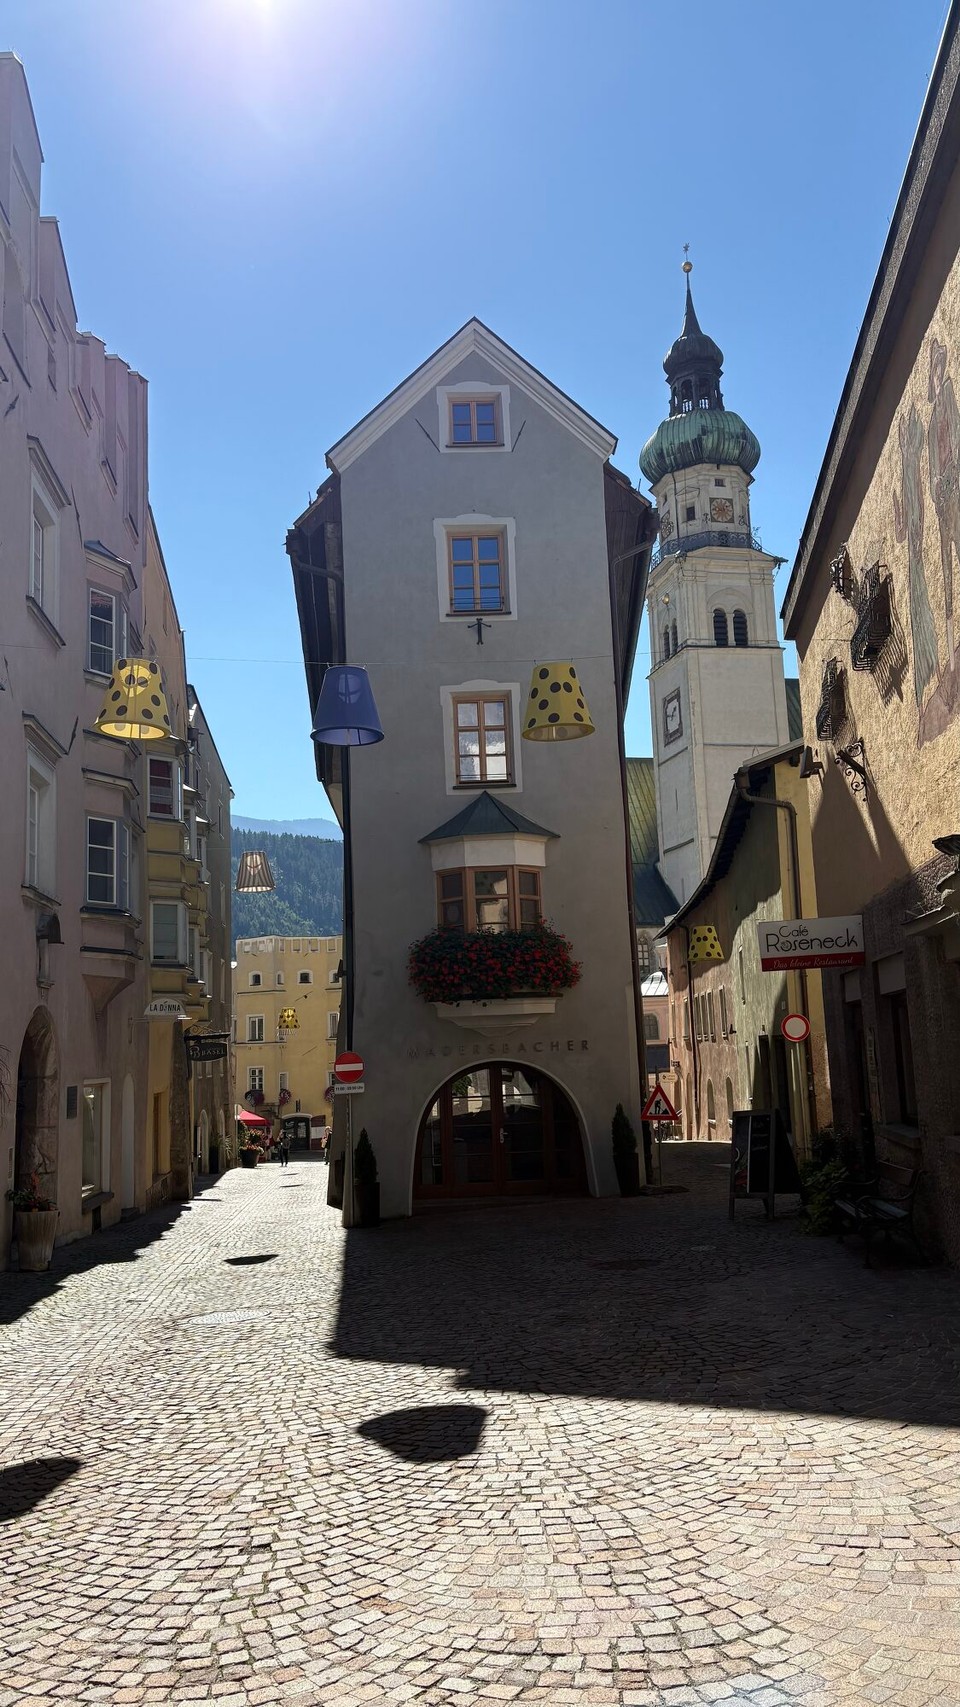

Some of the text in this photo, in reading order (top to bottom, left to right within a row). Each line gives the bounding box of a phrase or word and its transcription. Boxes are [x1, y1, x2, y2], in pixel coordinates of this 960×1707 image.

[779, 924, 809, 938] Café
[766, 928, 858, 952] Roseneck
[149, 1003, 158, 1012] LA
